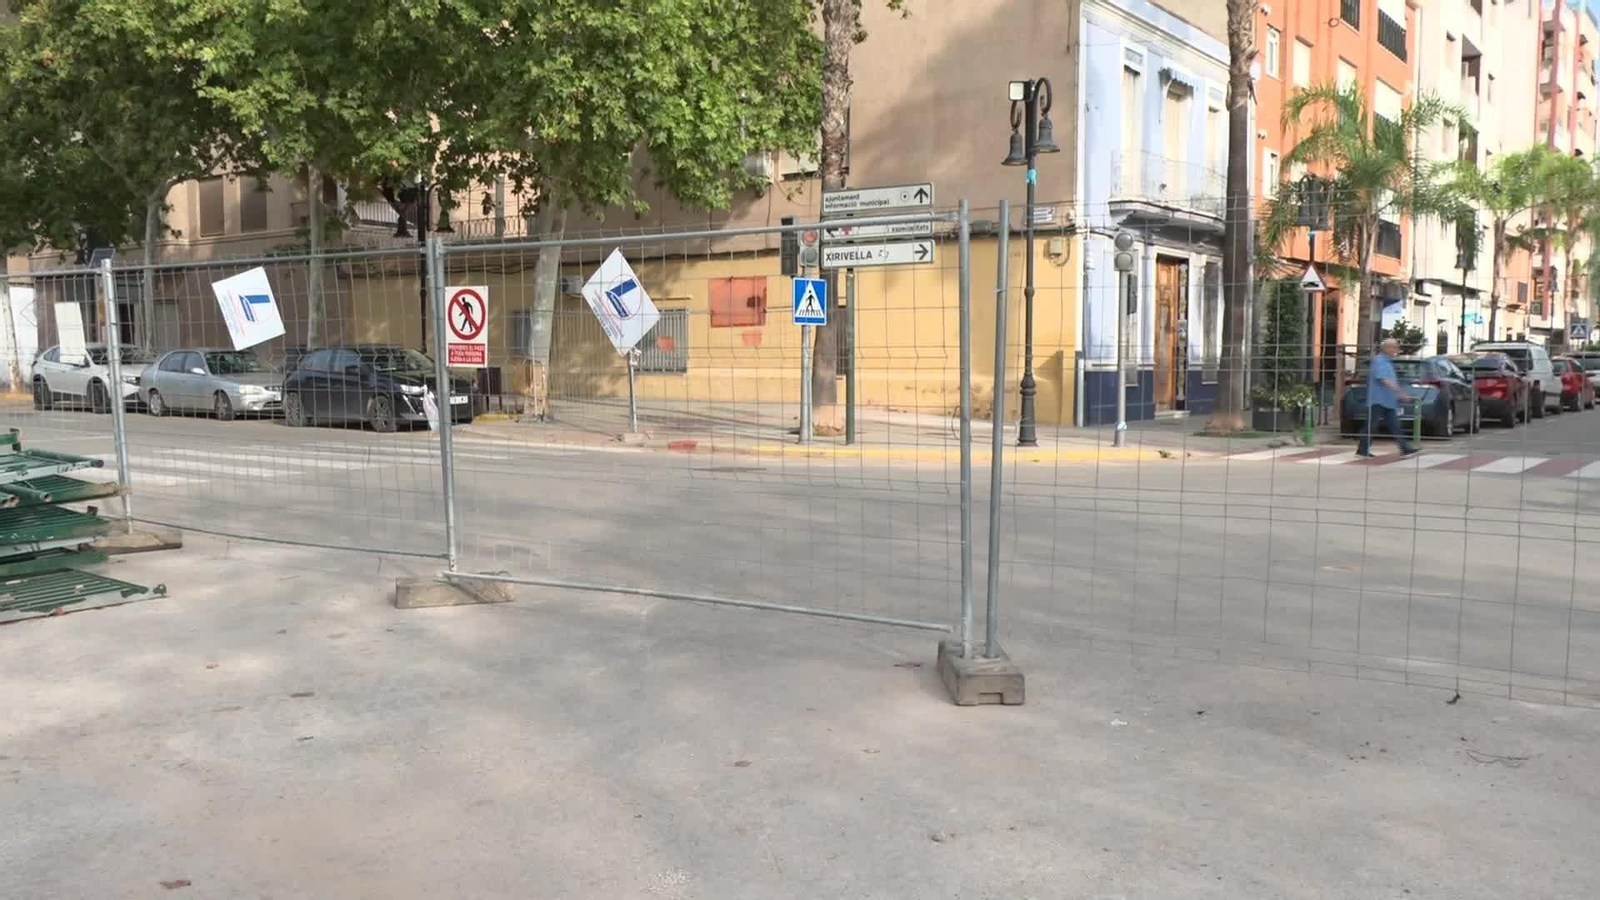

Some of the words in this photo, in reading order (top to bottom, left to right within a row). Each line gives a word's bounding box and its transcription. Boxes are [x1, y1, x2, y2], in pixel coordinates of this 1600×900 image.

[825, 194, 860, 202] ajuntament
[860, 199, 890, 207] municipal
[826, 250, 873, 261] XIRIVELLA
